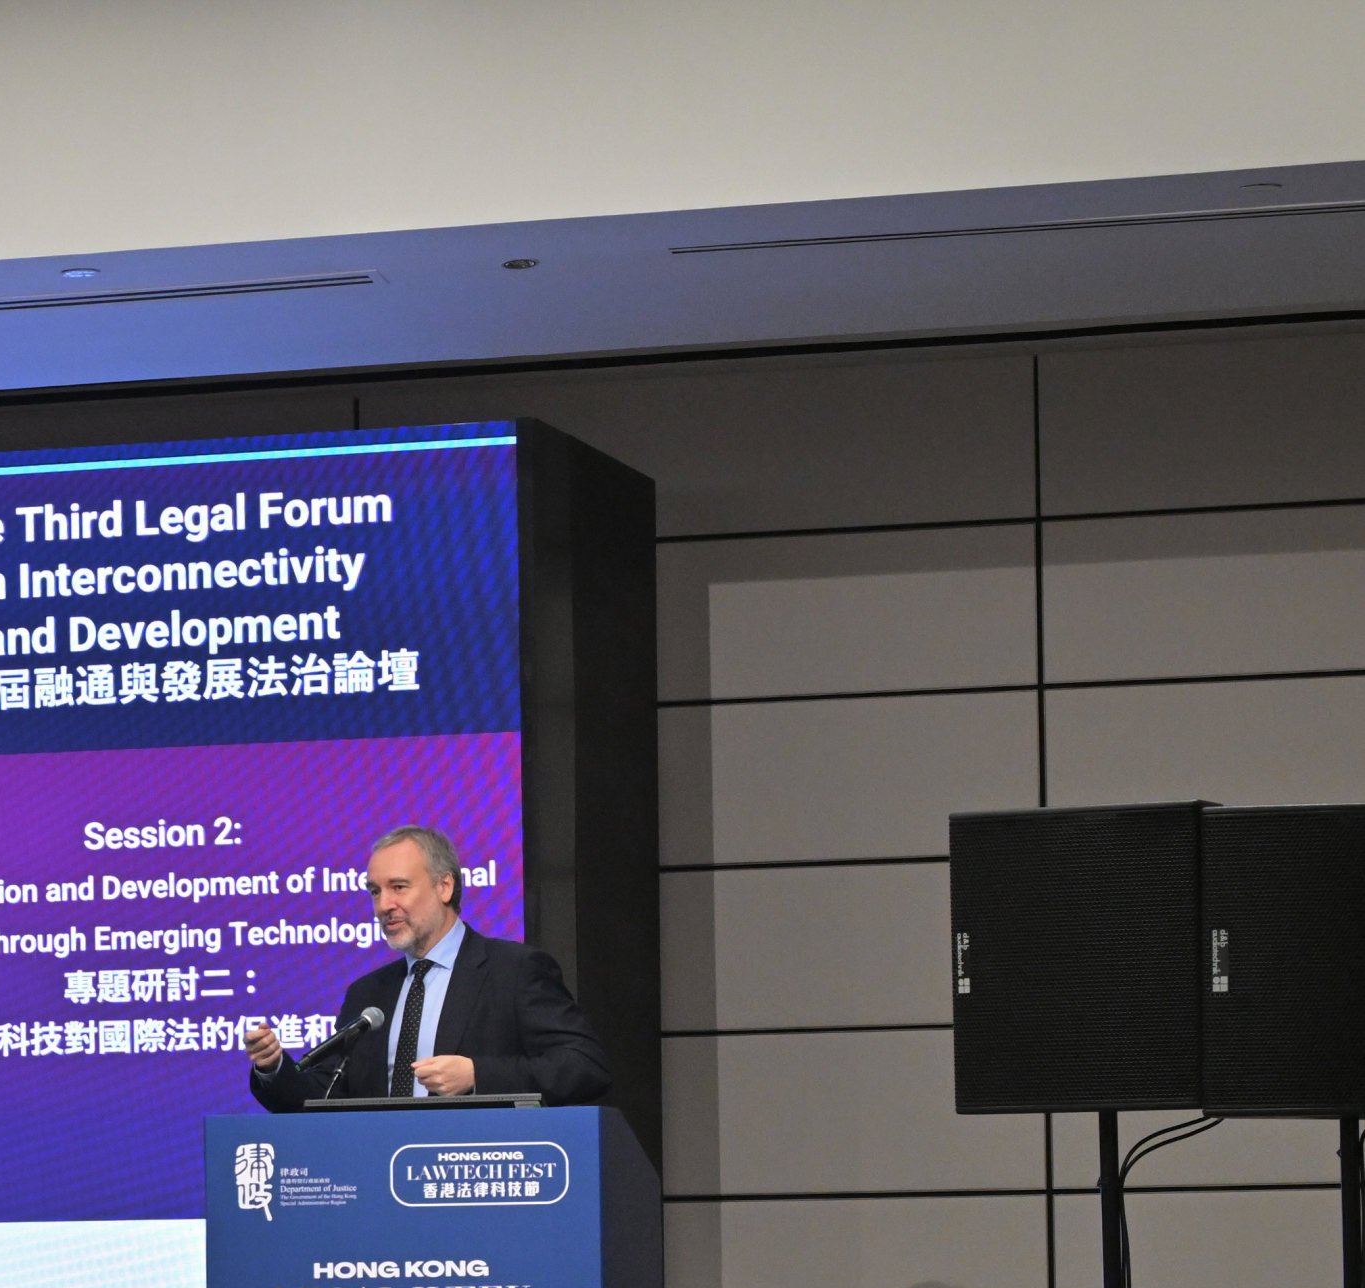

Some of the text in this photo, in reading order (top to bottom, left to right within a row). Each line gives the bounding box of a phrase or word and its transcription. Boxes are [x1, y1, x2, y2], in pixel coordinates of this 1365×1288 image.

[15, 500, 122, 542] Third
[136, 492, 245, 542] Legal
[259, 492, 392, 529] Forum
[20, 546, 365, 598] Interconnectivity
[69, 605, 341, 655] Development
[84, 816, 241, 850] Session 2:
[45, 875, 94, 902] and
[102, 871, 279, 903] Development
[286, 866, 315, 893] of
[95, 923, 221, 955] Emerging
[407, 1163, 556, 1181] LAWTECH FEST
[438, 1151, 524, 1161] HONG KONG
[280, 1168, 308, 1177] 律政司
[280, 1184, 357, 1195] Department of Justice
[313, 1260, 489, 1279] HONG KONG
